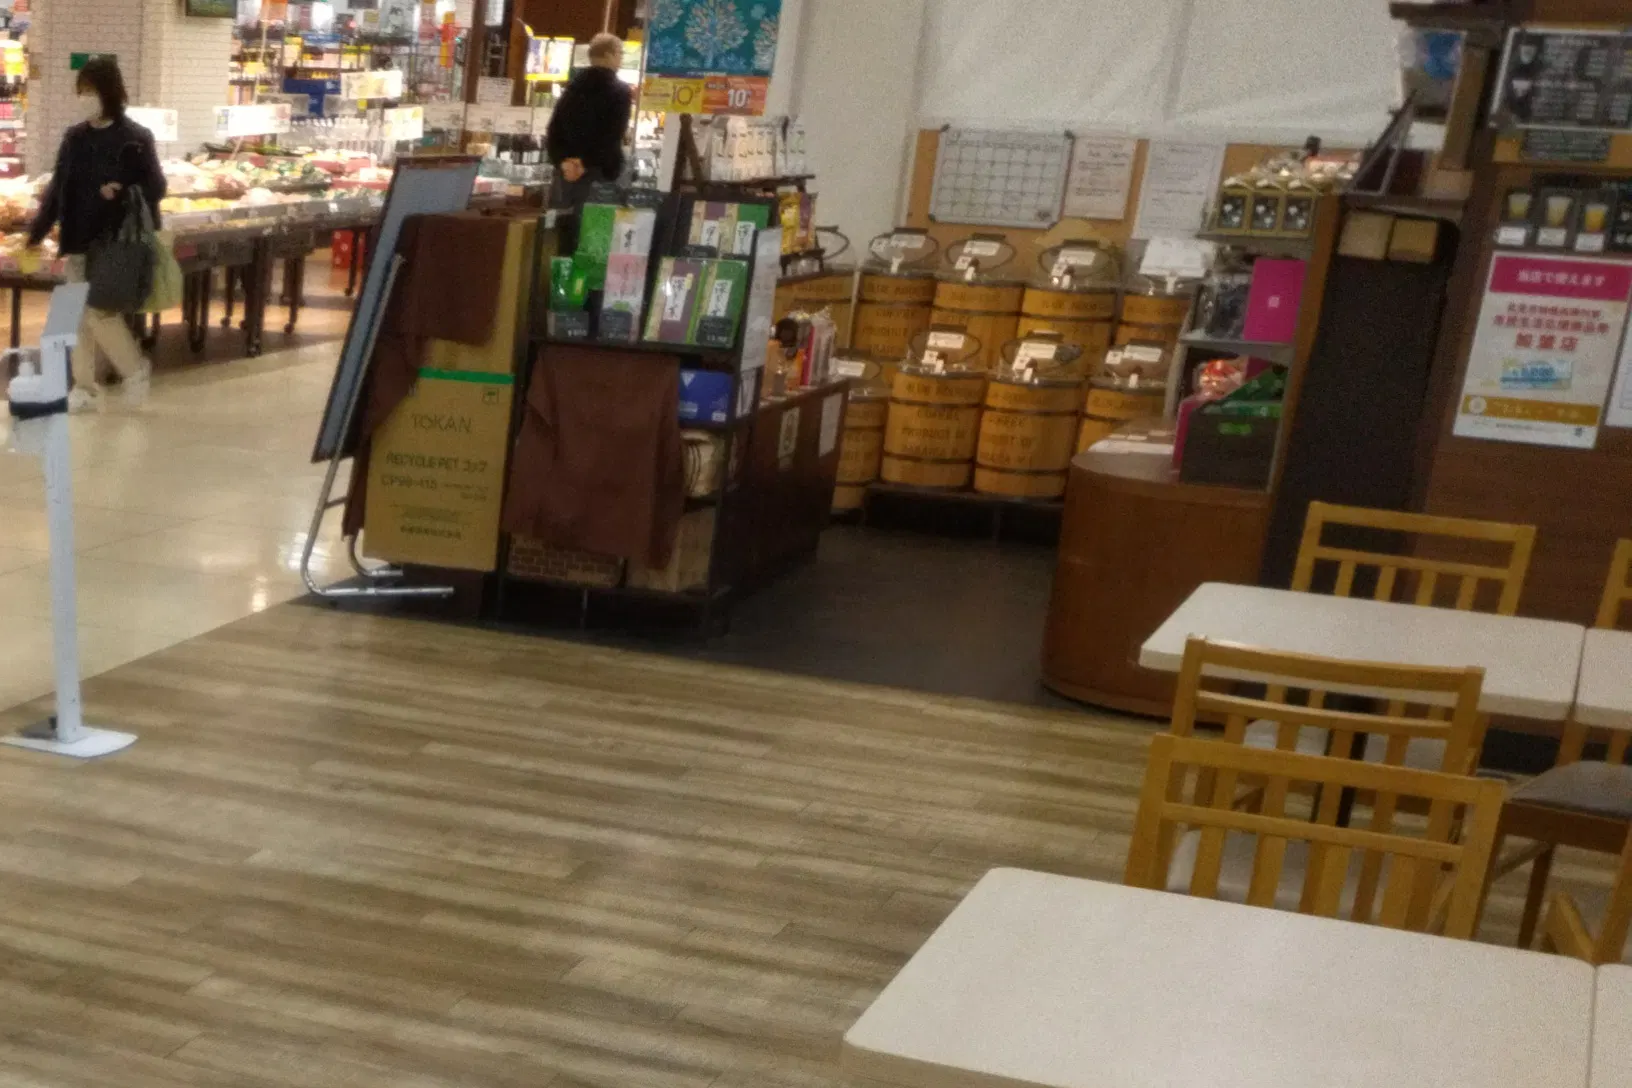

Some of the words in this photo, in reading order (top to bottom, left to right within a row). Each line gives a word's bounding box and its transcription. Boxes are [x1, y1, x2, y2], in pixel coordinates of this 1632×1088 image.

[1518, 270, 1606, 287] 当店で使えます
[411, 413, 472, 433] TOKAN
